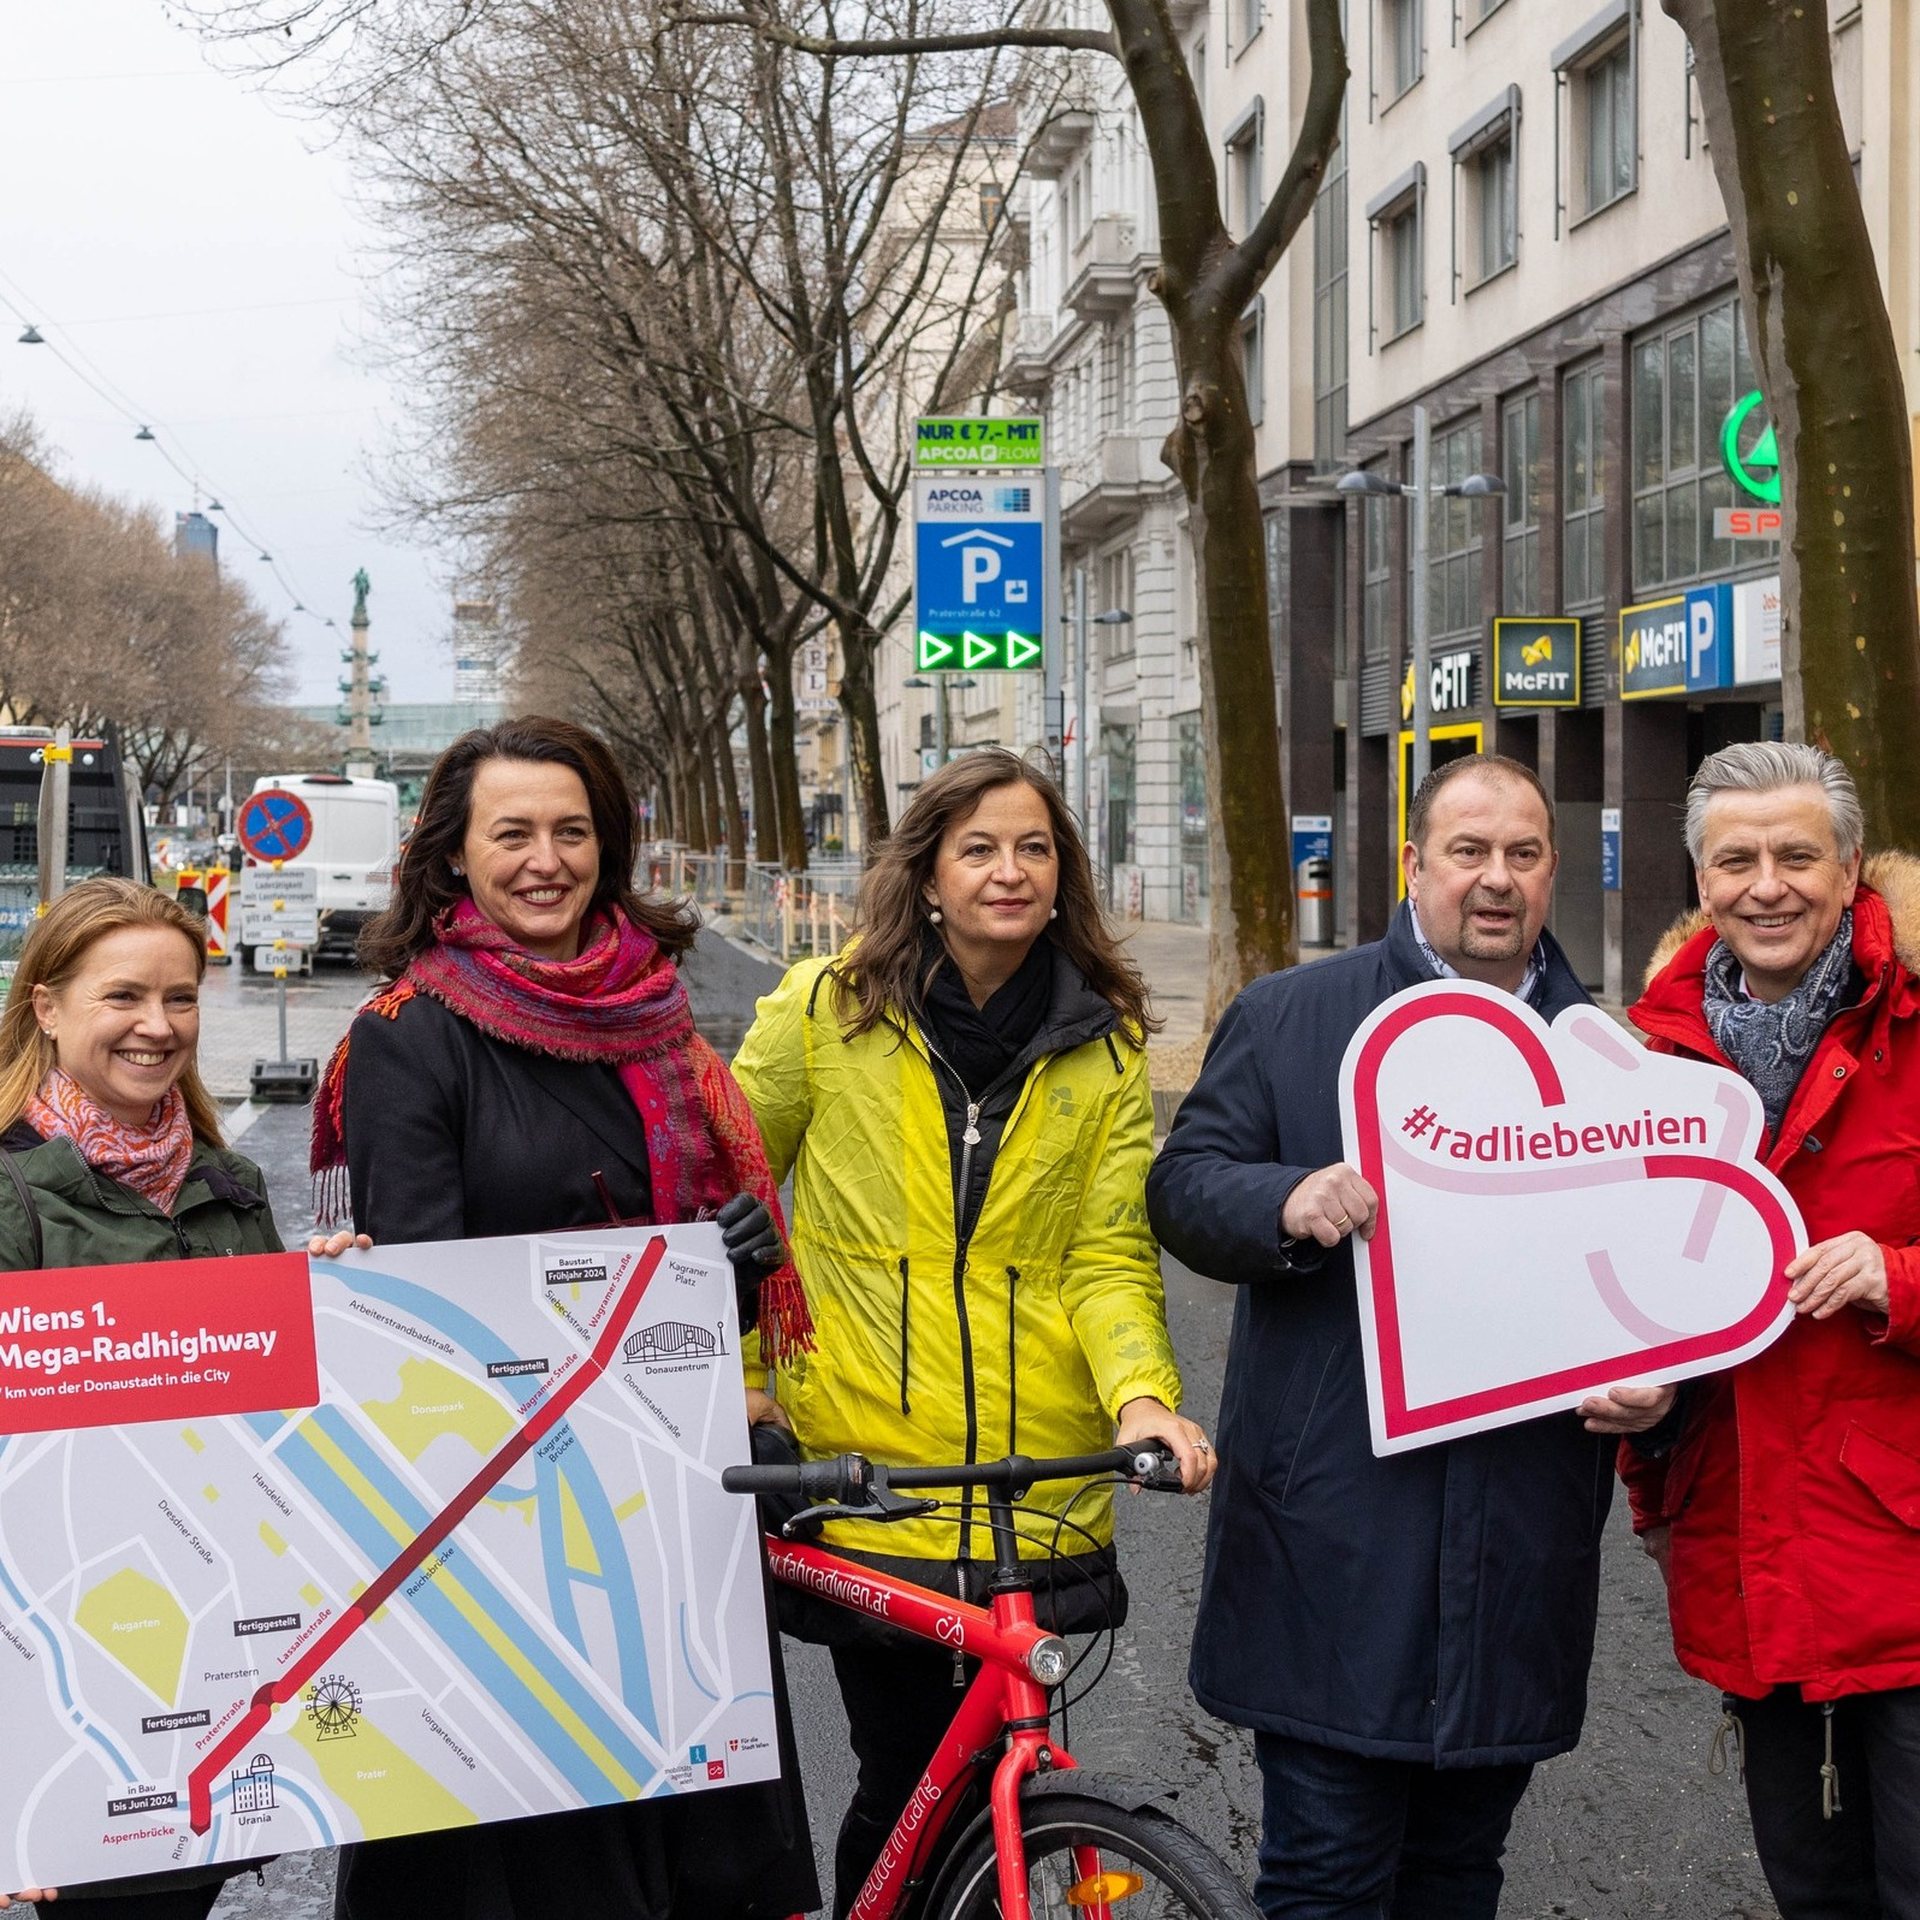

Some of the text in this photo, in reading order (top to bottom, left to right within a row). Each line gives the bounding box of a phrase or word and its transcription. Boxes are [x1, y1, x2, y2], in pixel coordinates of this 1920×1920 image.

[917, 424, 954, 440] NUR
[960, 424, 971, 440] €
[1007, 424, 1039, 440] MIT
[919, 446, 979, 461] APCOA
[999, 446, 1039, 460] FLOW
[928, 489, 983, 501] APCOA
[927, 502, 984, 513] PARKING
[1729, 512, 1781, 534] SP
[962, 547, 1001, 603] P
[928, 608, 985, 618] Praterstraße
[1640, 620, 1686, 669] McFIT
[1690, 600, 1715, 679] P
[1430, 652, 1472, 712] cFIT
[1505, 672, 1569, 690] McFIT
[245, 914, 272, 923] gilt ab
[281, 929, 294, 937] bis
[265, 953, 293, 965] Ende
[1401, 1104, 1707, 1162] #radliebewien
[559, 1257, 593, 1266] Baustart
[669, 1260, 708, 1278] Kagraner
[548, 1268, 604, 1281] Frühjahr 2024
[675, 1275, 696, 1287] Platz
[588, 1253, 632, 1328] Wagramer Straße
[0, 1301, 116, 1335] Wiens 1.
[544, 1289, 591, 1342] Siebeckstraße
[349, 1299, 455, 1355] Arbeiterstrandbadstraße
[0, 1328, 277, 1375] Mega-Radhighway
[491, 1361, 546, 1374] fertiggestellt
[645, 1362, 710, 1375] Donauzentrum
[5, 1386, 27, 1399] km
[30, 1386, 55, 1397] von
[58, 1381, 81, 1394] der
[84, 1374, 163, 1393] Donaustadt
[166, 1373, 178, 1386] in
[181, 1371, 201, 1384] die
[204, 1369, 231, 1383] City
[517, 1352, 579, 1416] Wagramer Straße
[411, 1401, 465, 1415] Donaupark
[624, 1373, 681, 1439] Donaustadtstraße
[537, 1423, 570, 1459] Kagraner
[548, 1436, 575, 1463] Brücke
[252, 1472, 293, 1517] Handelskai
[158, 1499, 214, 1565] Dresdner Straße
[406, 1547, 455, 1598] Reichsbrücke
[112, 1618, 161, 1633] Augarten
[238, 1617, 297, 1632] fertiggestellt
[277, 1607, 332, 1665] Lassallestraße
[204, 1667, 259, 1682] Praterstern
[146, 1713, 207, 1729] fertiggestellt
[195, 1699, 245, 1750] Praterstraße
[421, 1708, 476, 1771] Vorgartenstraße
[356, 1769, 387, 1780] Prater
[128, 1784, 156, 1794] in Bau
[113, 1796, 174, 1812] bis Juni 2024
[902, 1771, 942, 1831] Gang
[238, 1813, 272, 1826] Urania
[102, 1825, 175, 1845] Aspernbrücke
[172, 1834, 188, 1860] Ring
